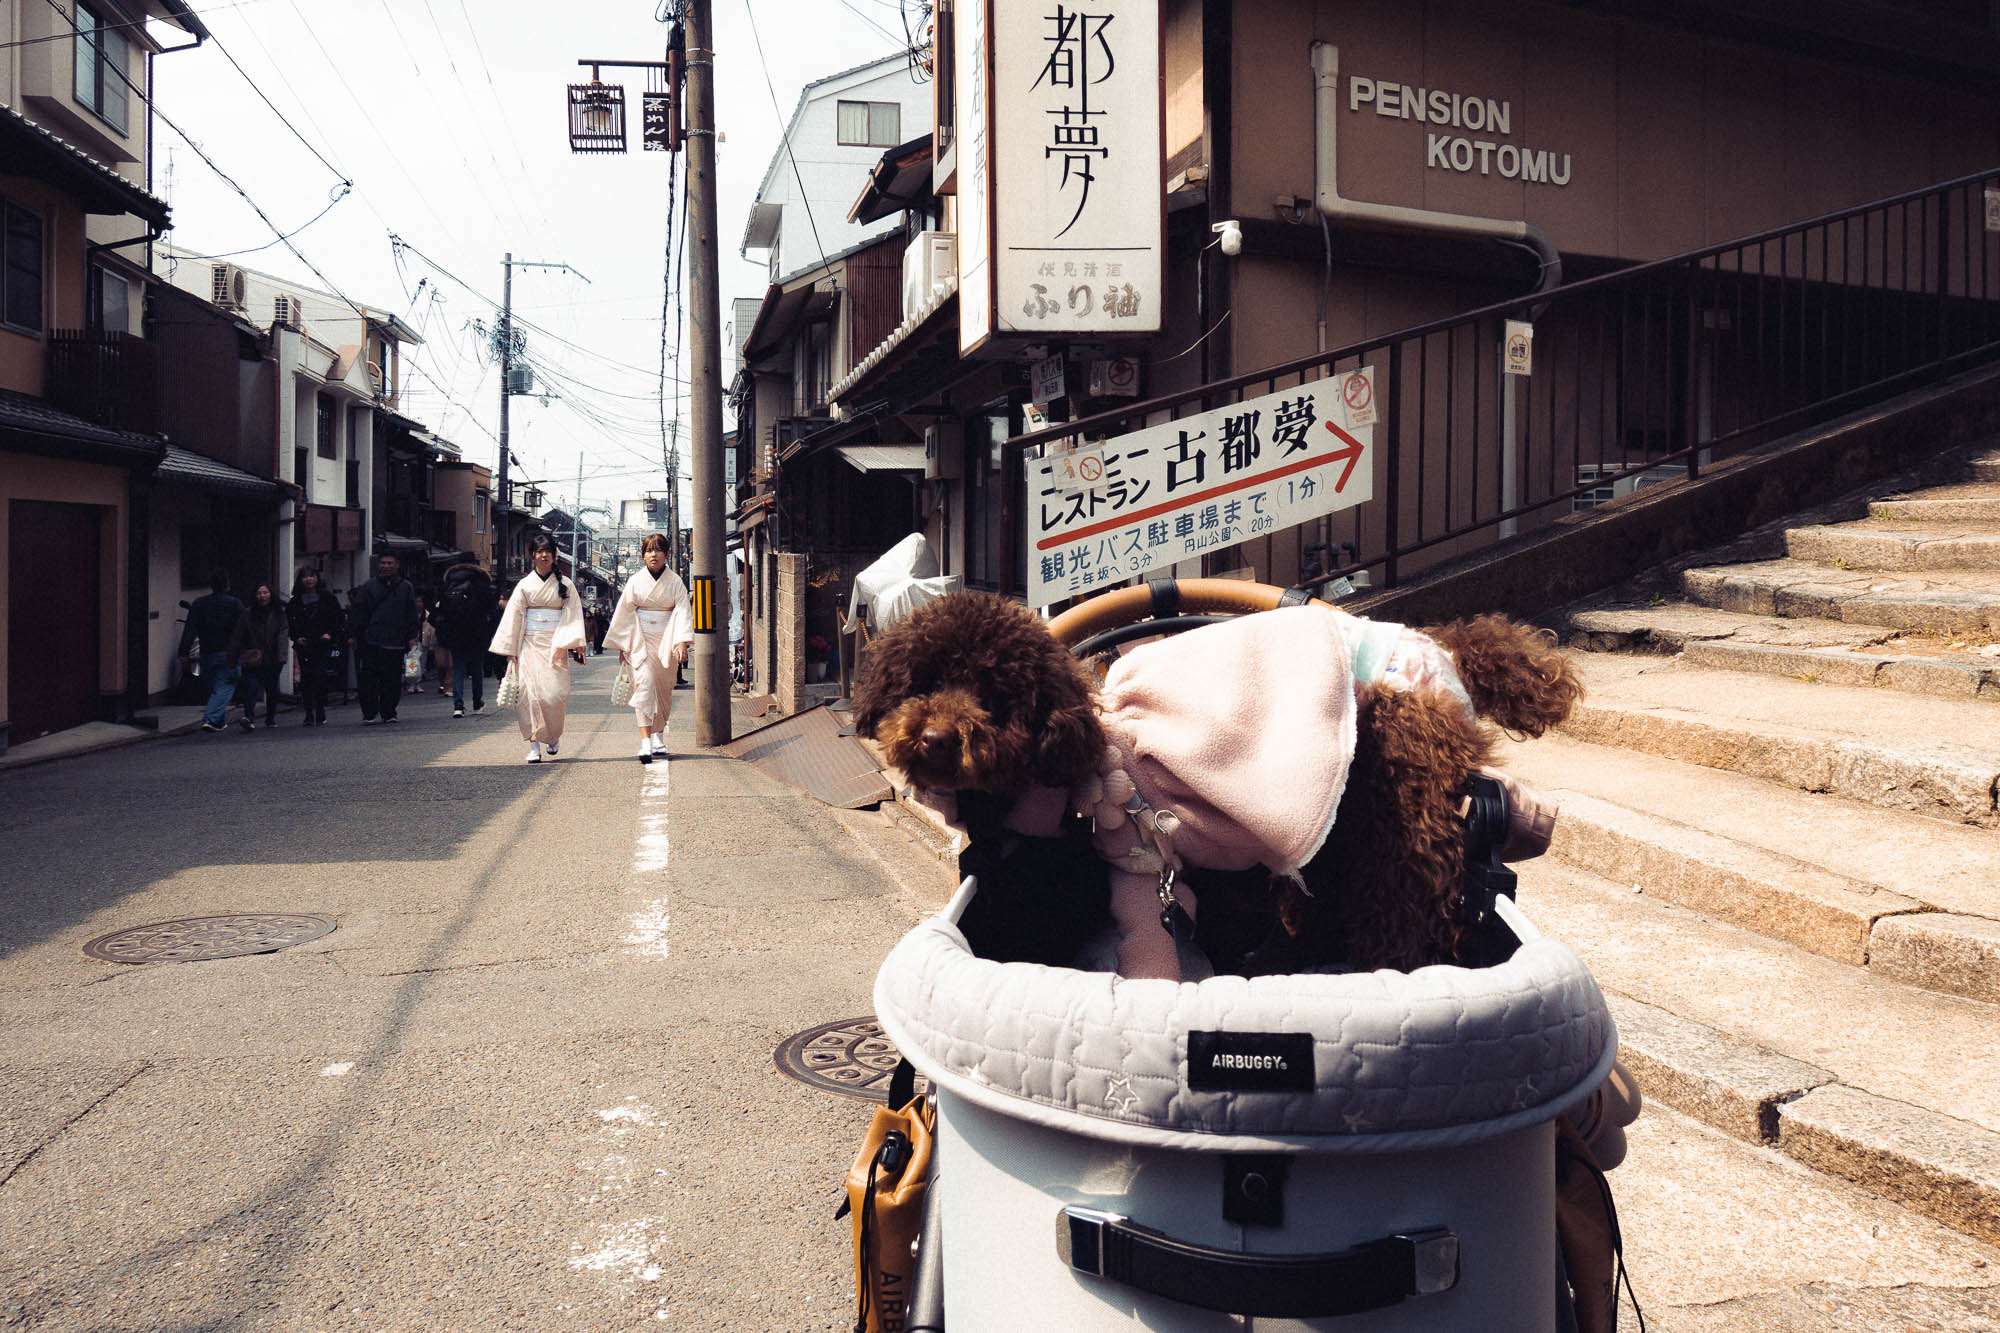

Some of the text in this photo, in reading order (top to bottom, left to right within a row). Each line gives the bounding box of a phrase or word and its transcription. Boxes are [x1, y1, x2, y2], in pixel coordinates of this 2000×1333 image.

[644, 99, 666, 152] 茶わん坂
[1349, 75, 1511, 134] PENSION
[1427, 133, 1572, 186] KOTOMU
[1037, 261, 1123, 278] 伏見清酒
[1022, 281, 1142, 320] ふり袖
[1162, 394, 1317, 493] 古都夢
[1041, 477, 1151, 532] レストラン
